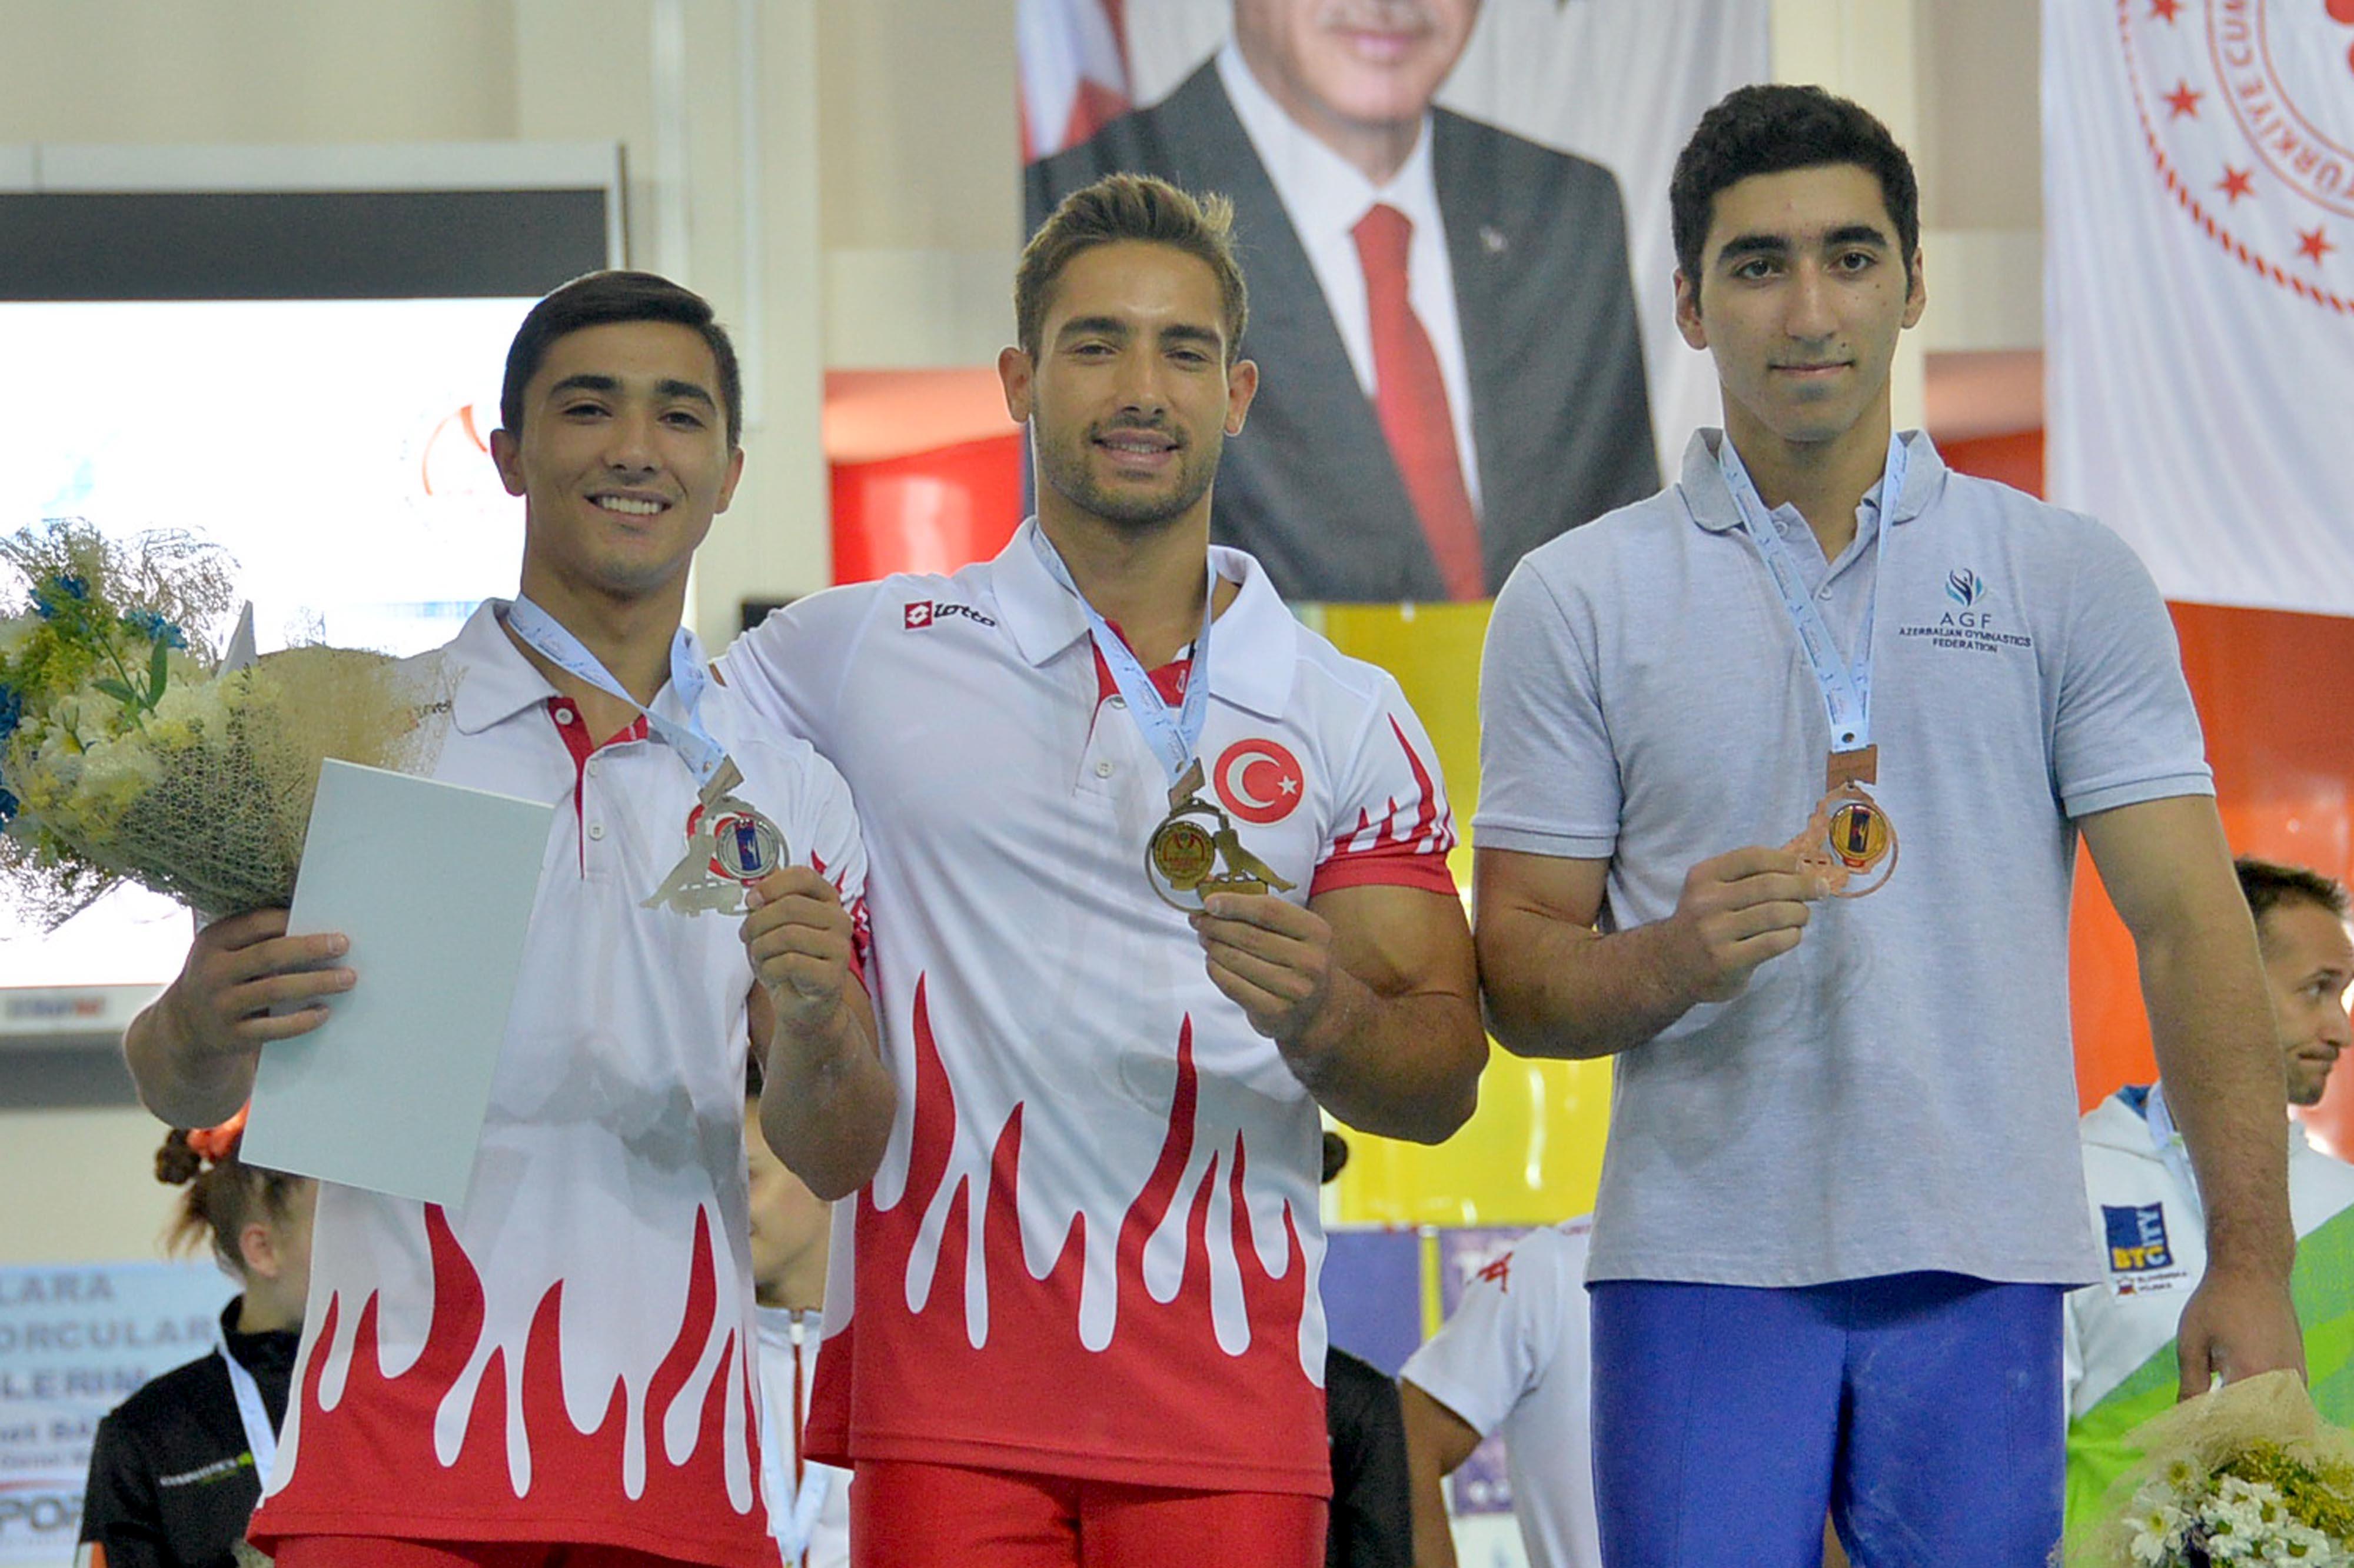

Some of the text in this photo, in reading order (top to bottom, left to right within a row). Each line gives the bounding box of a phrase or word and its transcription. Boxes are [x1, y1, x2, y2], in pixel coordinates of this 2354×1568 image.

[1899, 627, 2032, 648] AZERBAIJAN GYMNASTICS
[1933, 638, 1997, 652] FEDERATION
